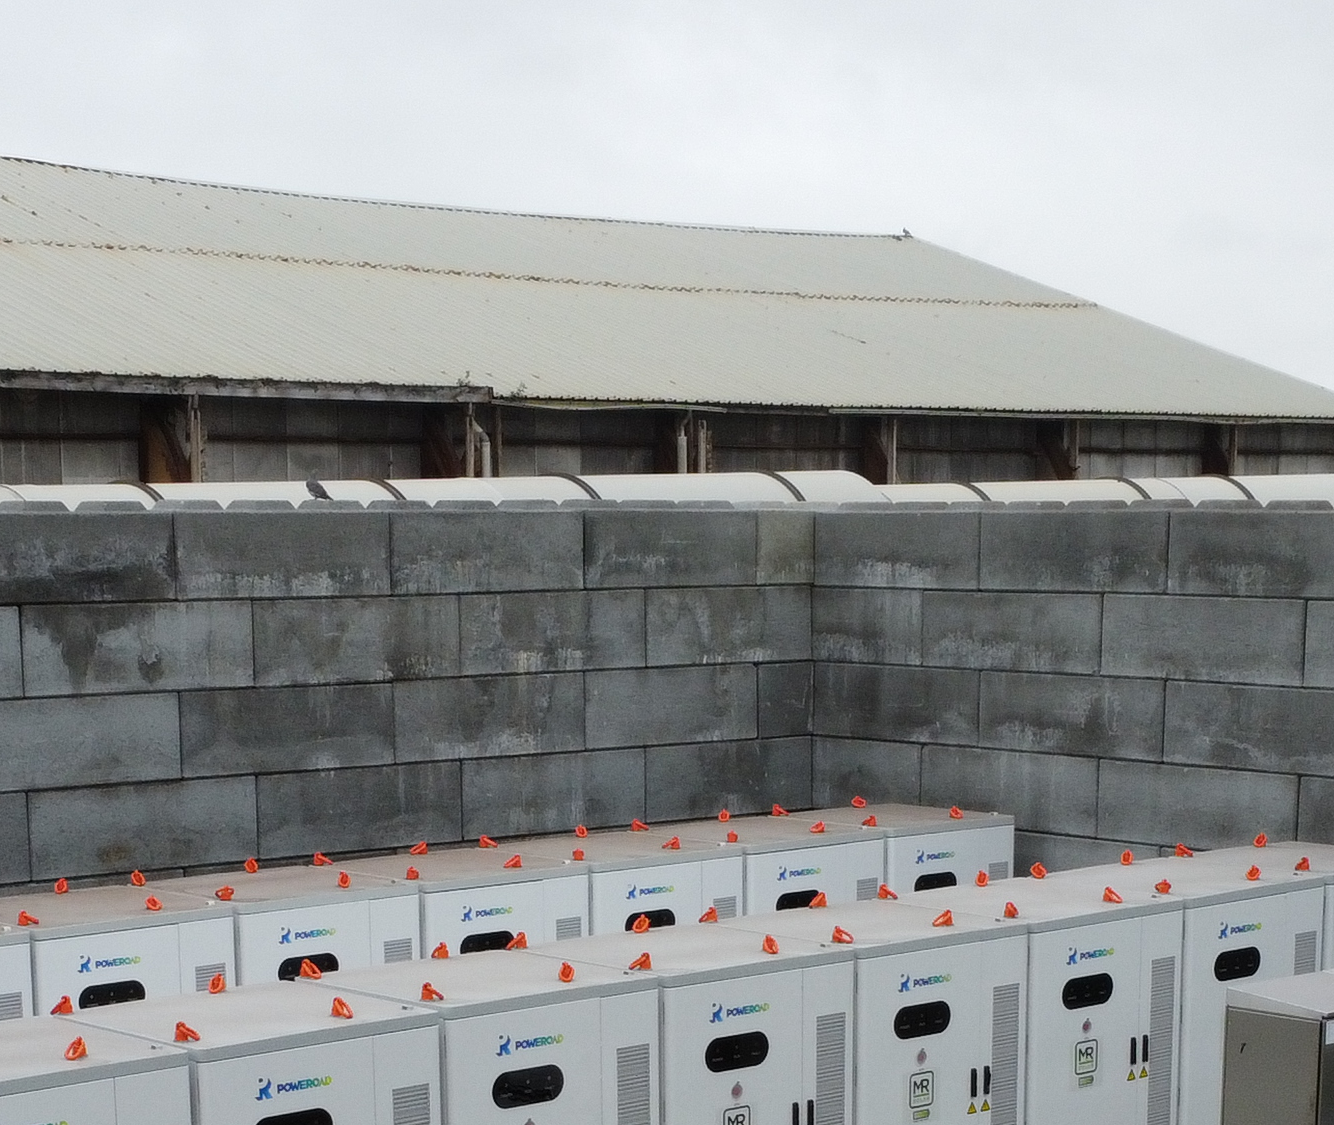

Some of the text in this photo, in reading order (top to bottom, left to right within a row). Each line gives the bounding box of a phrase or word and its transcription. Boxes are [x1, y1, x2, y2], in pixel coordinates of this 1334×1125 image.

[639, 886, 675, 896] POWEROAD
[475, 906, 513, 918] POWEROAD
[294, 928, 336, 940] POWEROAD
[1079, 947, 1115, 960] POWEROAD
[95, 956, 141, 969] POWEROAD
[913, 974, 953, 988] POWEROAD
[726, 1003, 771, 1018] POWEROAD
[515, 1034, 565, 1050] POWEROAD
[1078, 1046, 1094, 1061] MR
[276, 1075, 334, 1094] POWEROAD
[913, 1078, 930, 1094] MR
